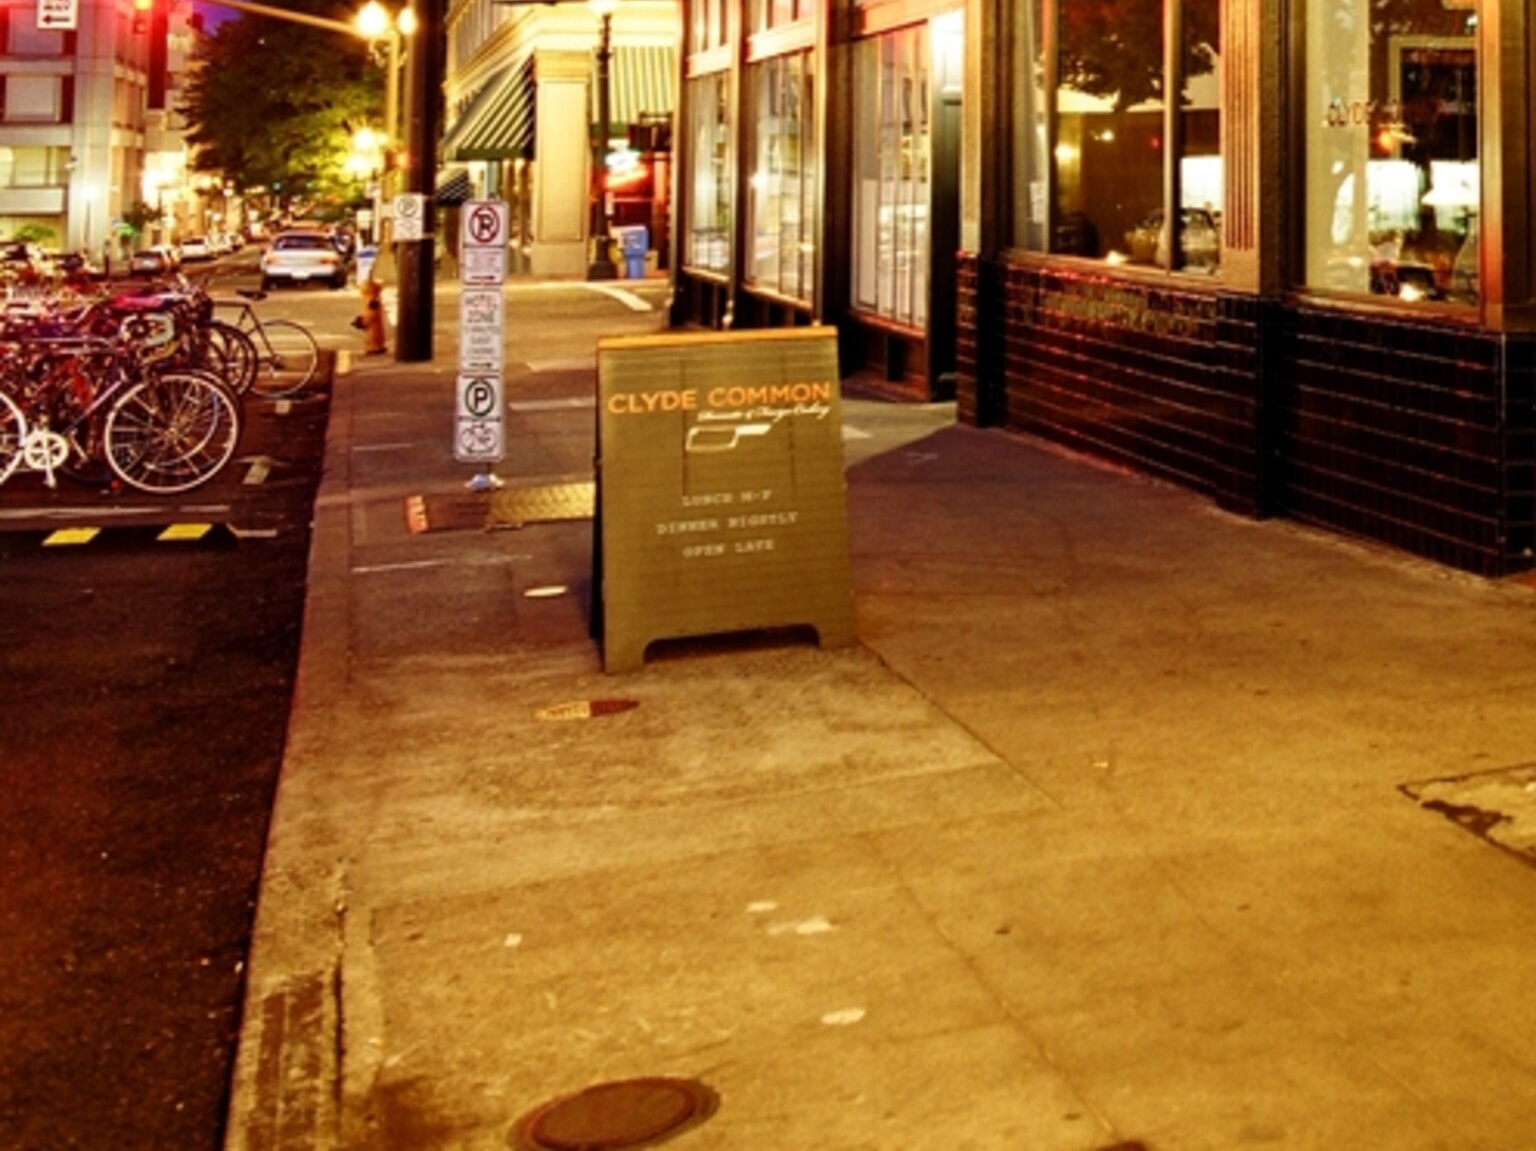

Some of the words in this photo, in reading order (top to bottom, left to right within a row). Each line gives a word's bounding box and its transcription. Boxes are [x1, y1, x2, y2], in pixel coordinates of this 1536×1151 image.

[608, 390, 697, 414] CLYDE
[707, 381, 831, 408] COMMON
[656, 518, 719, 535] DINNER
[727, 511, 799, 529] NIGHTLY
[682, 543, 726, 559] OPEN
[734, 539, 775, 553] LATE
